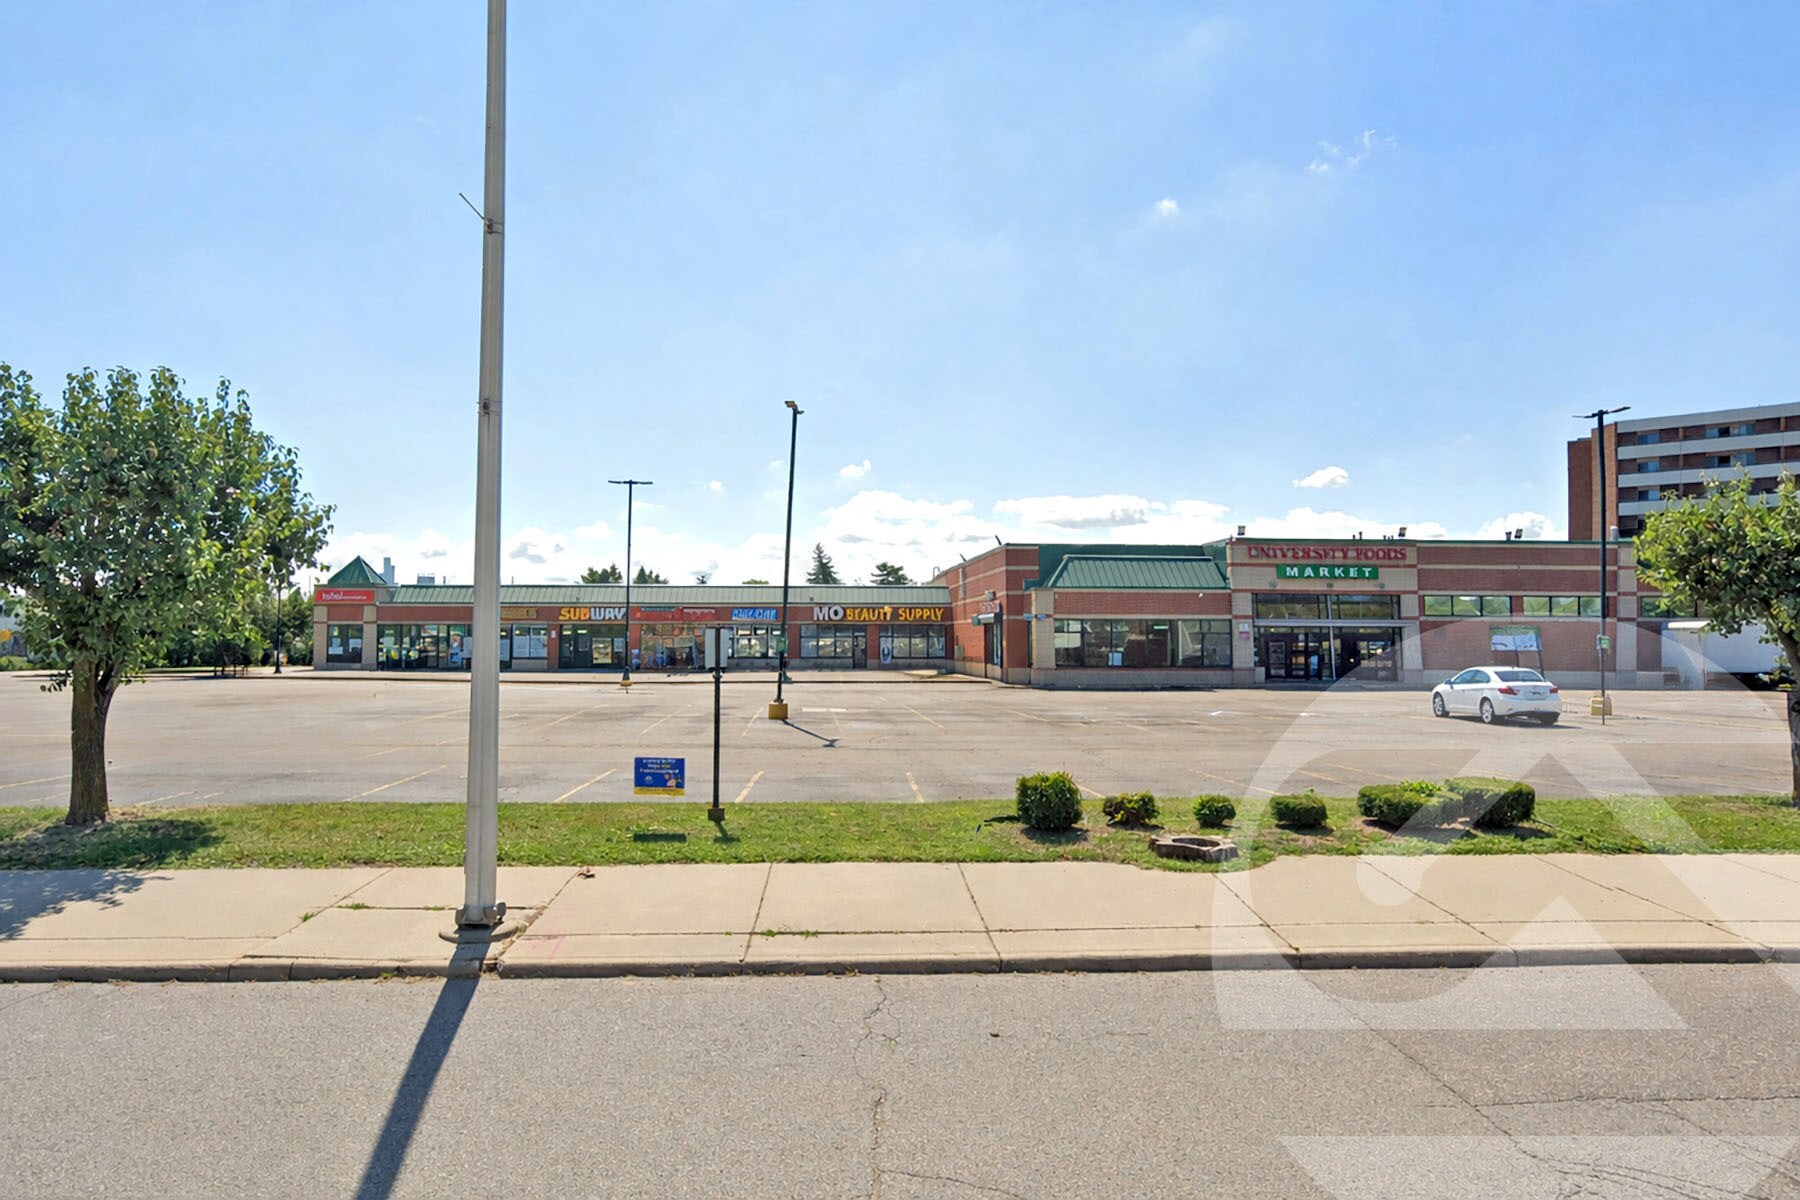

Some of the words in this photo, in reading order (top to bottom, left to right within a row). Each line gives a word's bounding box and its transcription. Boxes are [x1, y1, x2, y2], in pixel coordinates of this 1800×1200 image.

[1248, 545, 1351, 561] UNIVERSITY
[1356, 546, 1407, 561] FOODS
[1285, 566, 1372, 577] MARKET
[559, 607, 627, 620] SUBWAY
[813, 606, 844, 620] MO
[846, 605, 893, 620] BEAUTY
[898, 607, 944, 620] SUPPLY
